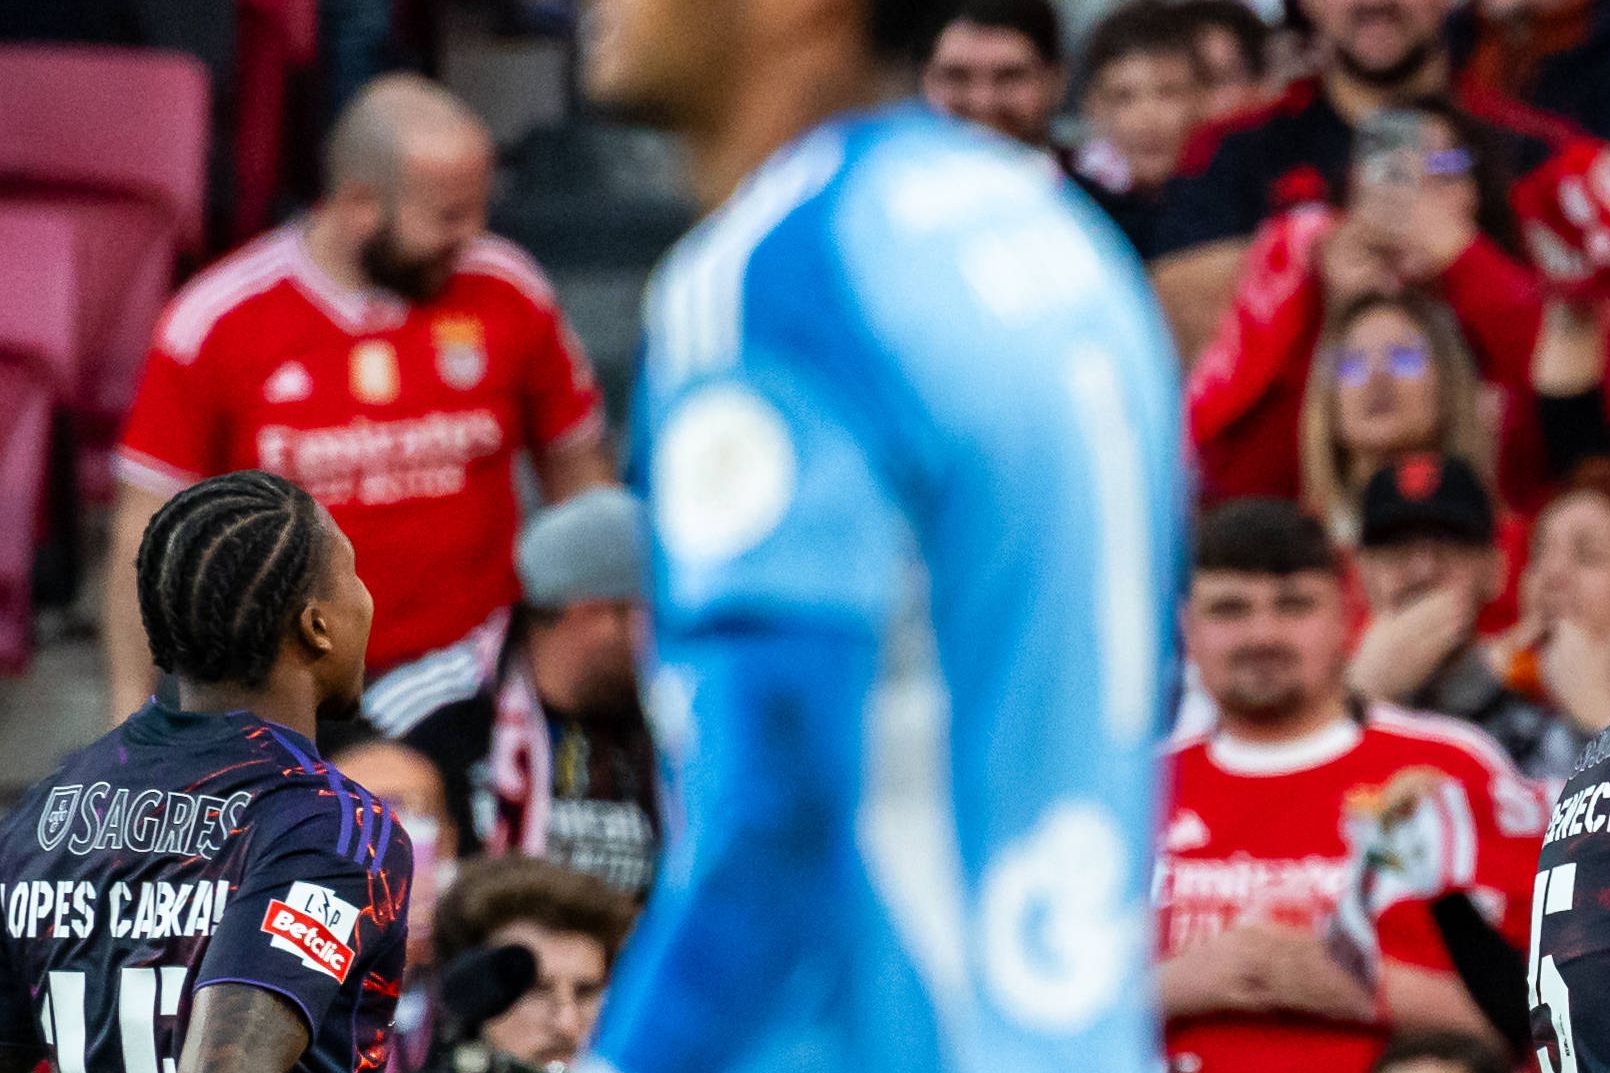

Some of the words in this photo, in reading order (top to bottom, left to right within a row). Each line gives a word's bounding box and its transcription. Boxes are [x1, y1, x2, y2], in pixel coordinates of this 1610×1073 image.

[68, 781, 253, 860] SAGRES
[0, 880, 97, 939] OPES
[271, 909, 345, 971] Betclic
